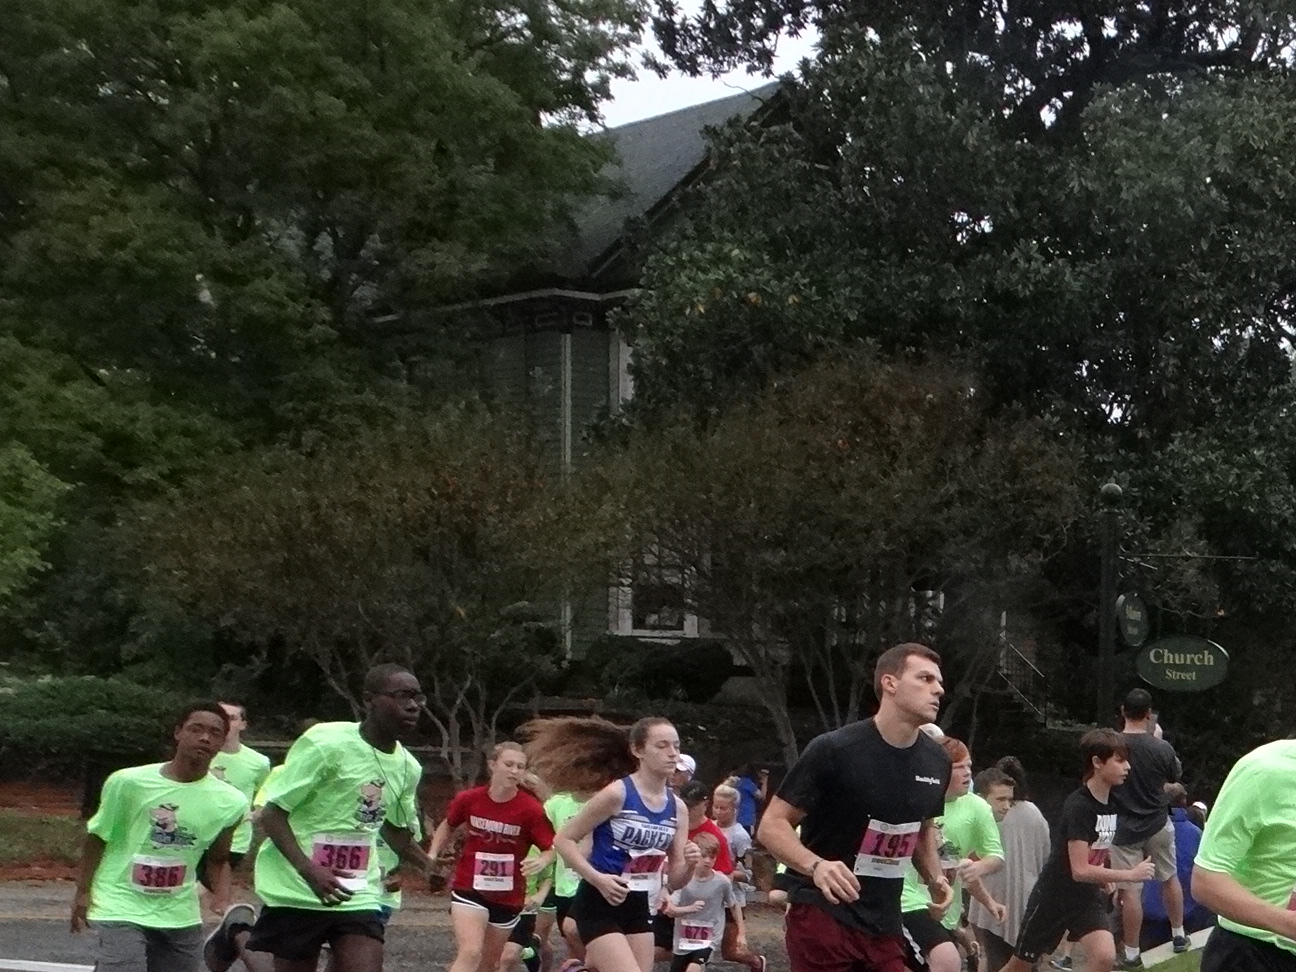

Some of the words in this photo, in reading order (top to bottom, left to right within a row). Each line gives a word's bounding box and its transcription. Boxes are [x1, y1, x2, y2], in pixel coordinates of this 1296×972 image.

[1149, 648, 1215, 666] Church
[1165, 668, 1197, 681] Street
[870, 832, 912, 858] 195
[321, 844, 362, 870] 366
[481, 860, 508, 876] 291
